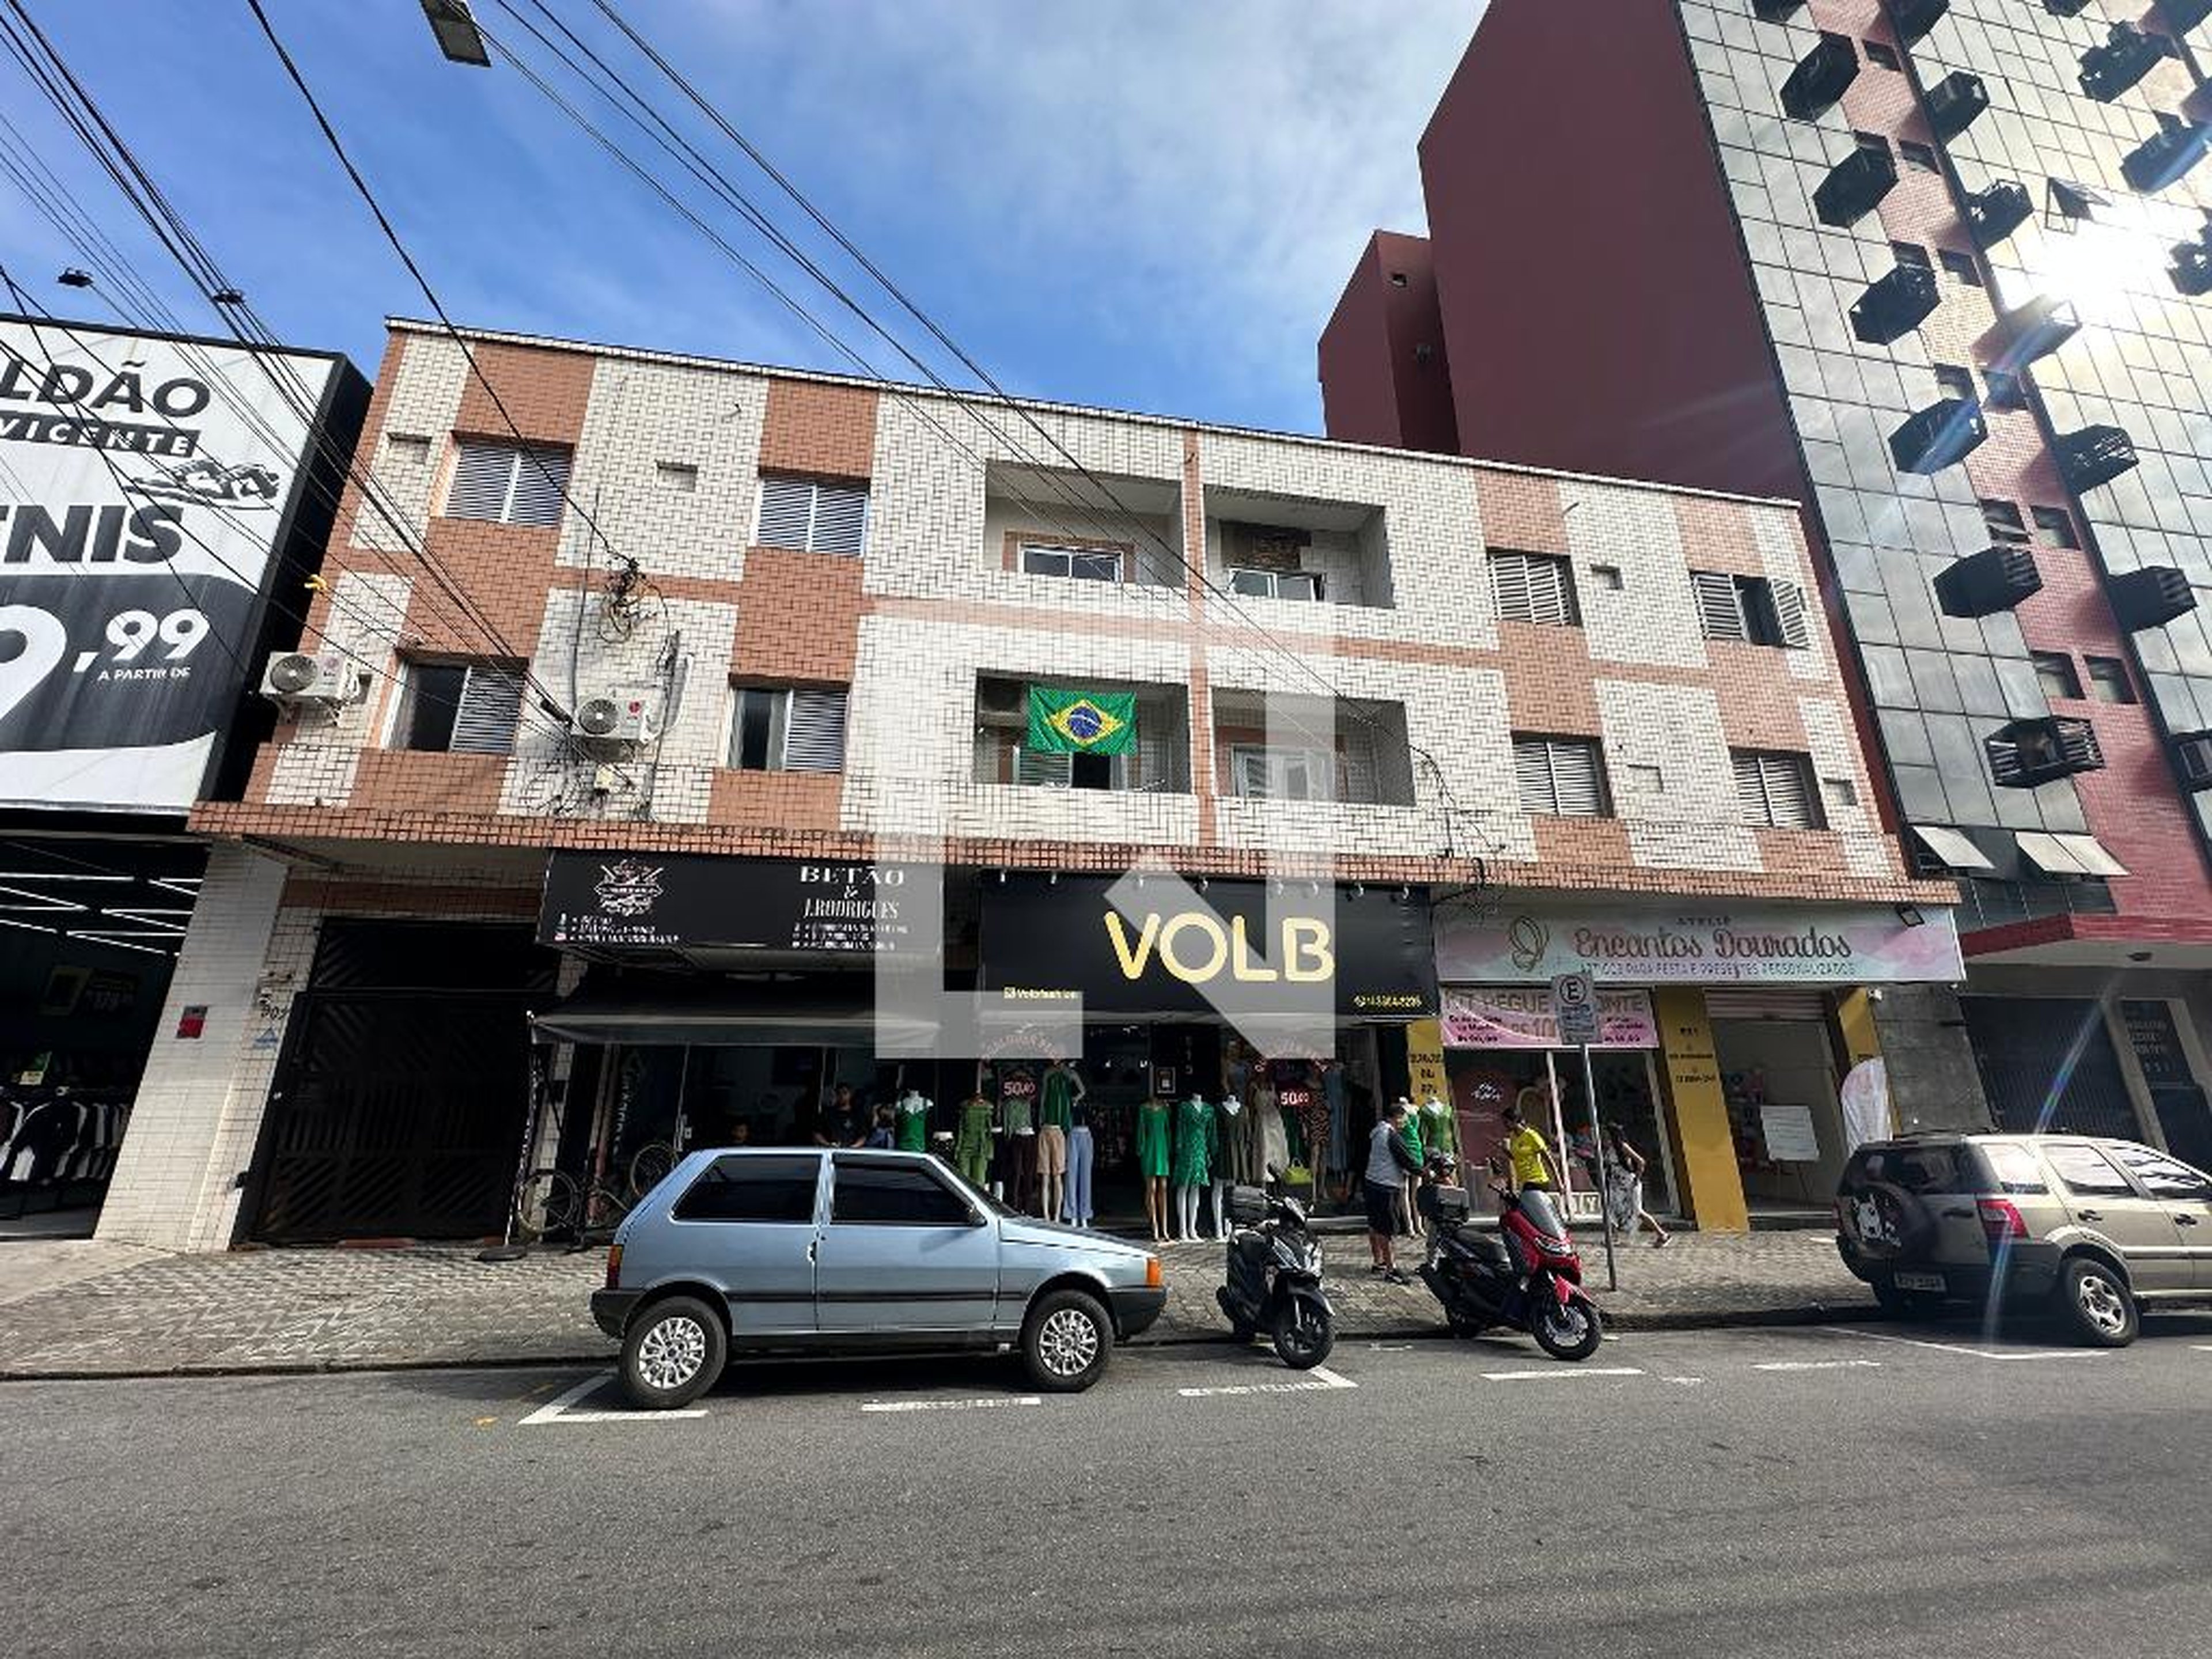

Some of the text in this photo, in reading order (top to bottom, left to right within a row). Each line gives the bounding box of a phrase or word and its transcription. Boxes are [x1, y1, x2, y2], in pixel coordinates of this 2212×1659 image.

[0, 505, 184, 563] NIS
[97, 669, 110, 680] A
[113, 668, 168, 680] PARTIR
[800, 865, 905, 885] BETÃO
[843, 885, 859, 899] &
[1103, 910, 1335, 983] VOLB
[1573, 925, 1852, 958] Encantos Dourados
[1566, 981, 1580, 1001] E
